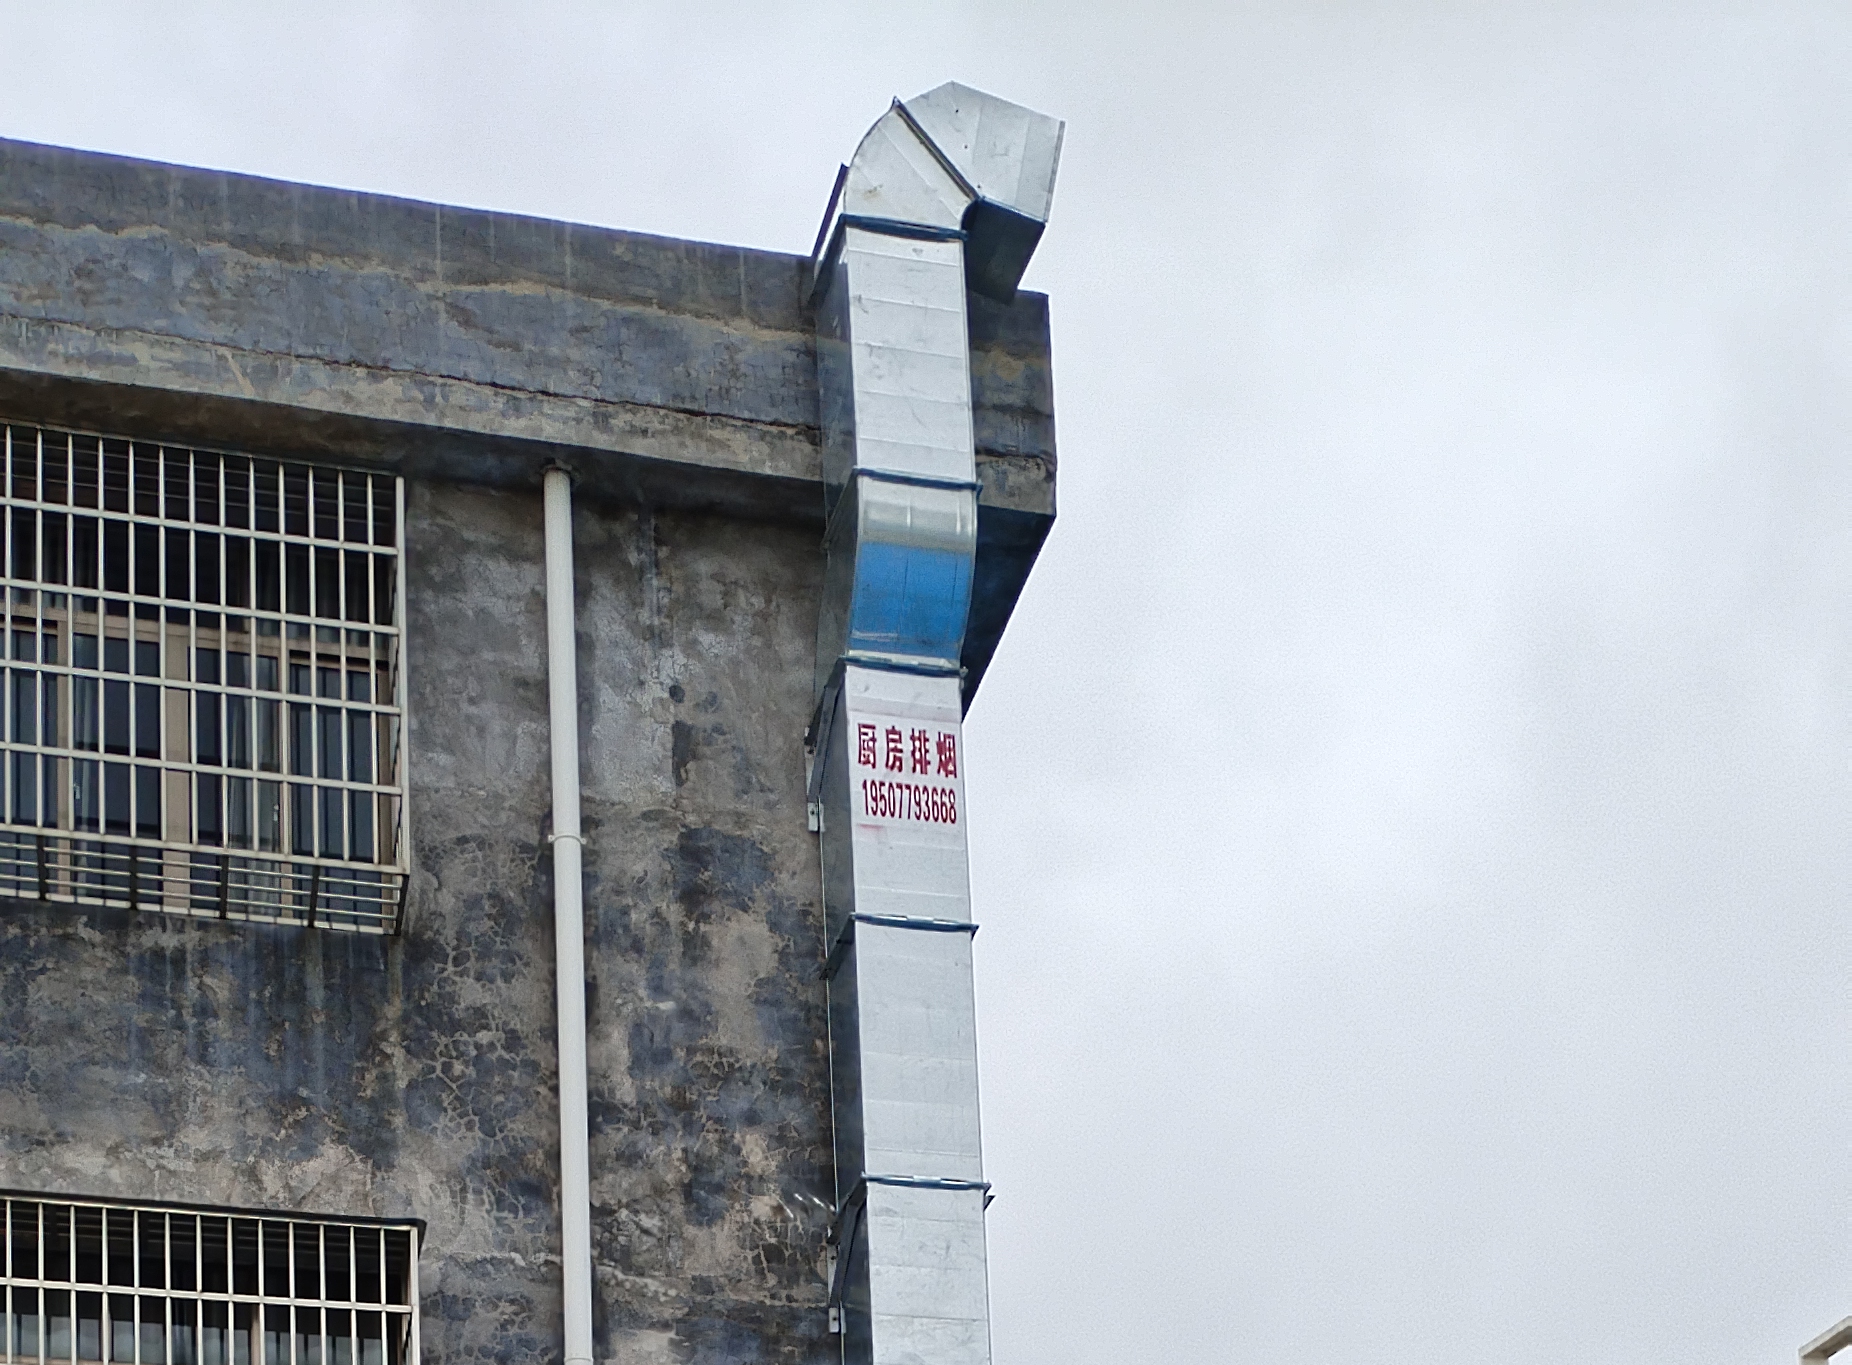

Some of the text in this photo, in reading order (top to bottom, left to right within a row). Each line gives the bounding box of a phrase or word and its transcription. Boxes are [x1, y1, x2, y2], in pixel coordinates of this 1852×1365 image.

[857, 723, 958, 778] 厨房排烟
[862, 779, 957, 824] 19507793668
